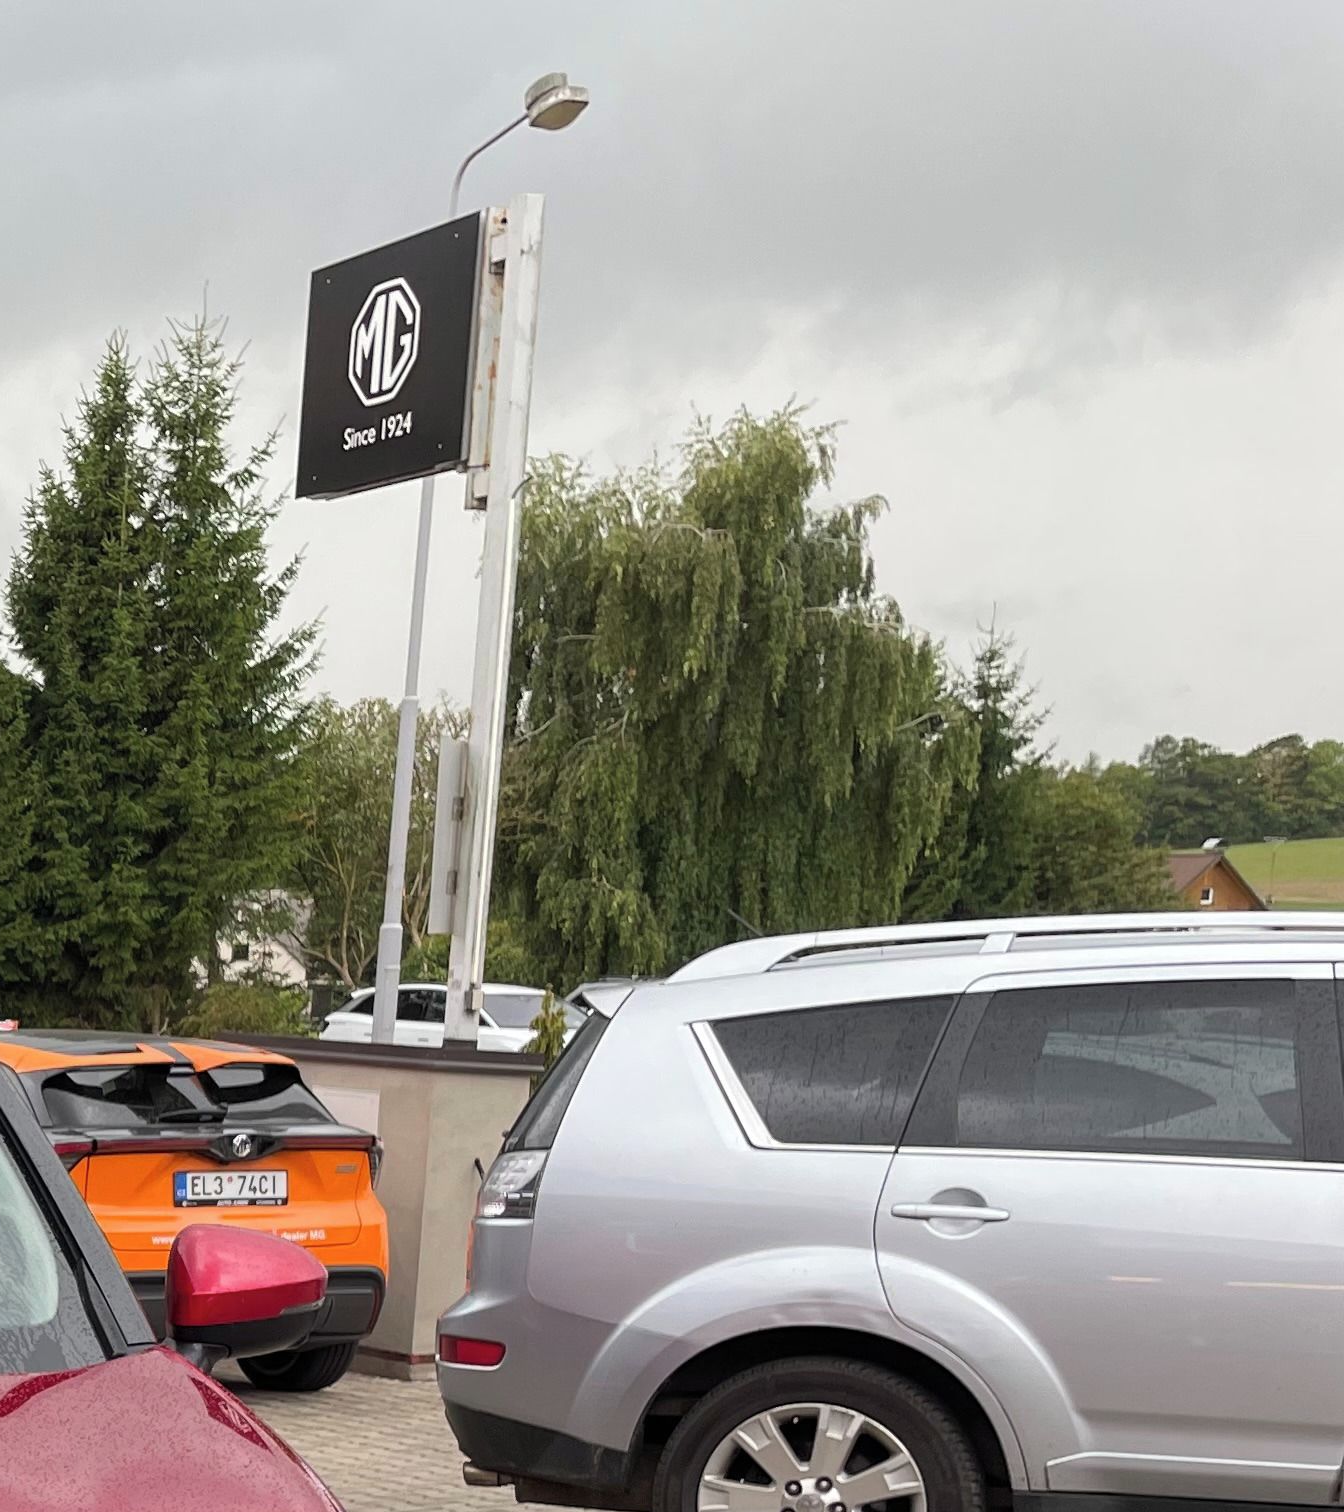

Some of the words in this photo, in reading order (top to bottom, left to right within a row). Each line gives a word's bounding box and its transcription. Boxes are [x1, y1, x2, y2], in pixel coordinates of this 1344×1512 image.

[355, 289, 414, 394] MG
[343, 427, 377, 451] Since
[380, 411, 412, 441] 1924
[191, 1175, 223, 1196] EL3
